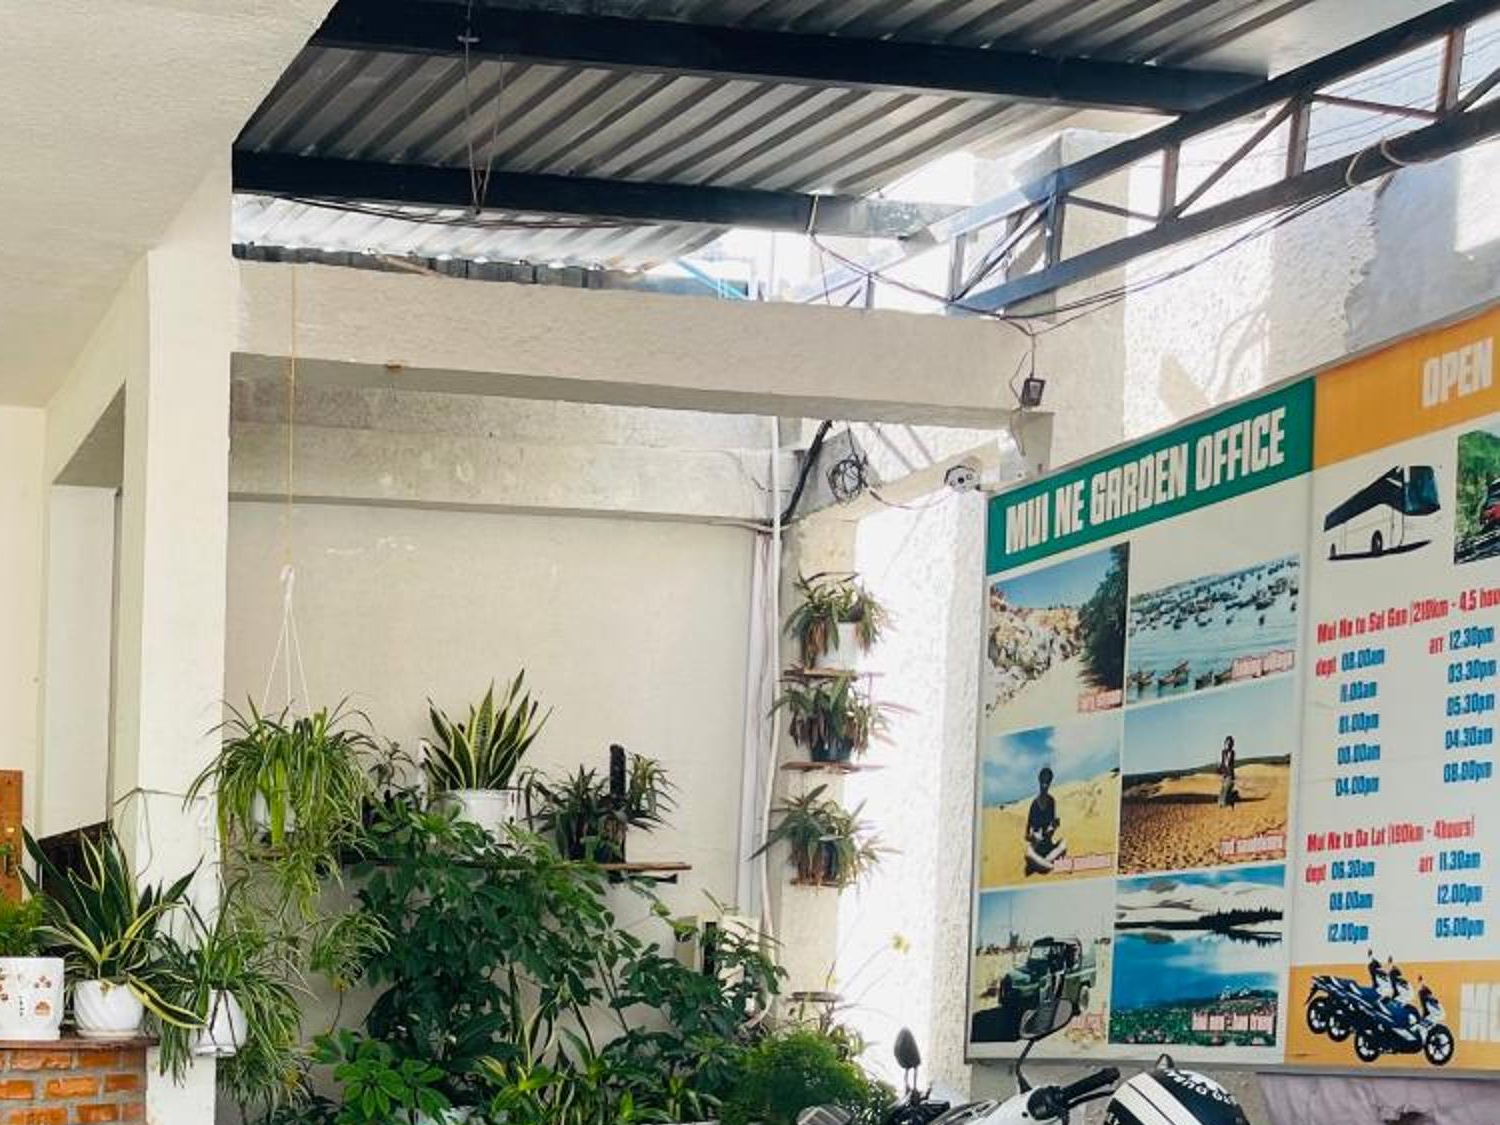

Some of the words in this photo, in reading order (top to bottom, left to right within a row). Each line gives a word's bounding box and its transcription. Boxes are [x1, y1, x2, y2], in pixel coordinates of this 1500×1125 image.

[1422, 336, 1493, 408] OPEN
[1005, 491, 1049, 555] MUI
[1053, 479, 1085, 539] NE
[1090, 442, 1188, 526] GARDEN
[1195, 405, 1287, 492] OFFICE
[1317, 622, 1337, 644] Mui
[1450, 626, 1495, 650] 12.30pm
[1448, 659, 1497, 683] 03.30pm
[1446, 692, 1495, 716] 05.30pm
[1307, 832, 1325, 852] Mui
[1327, 831, 1341, 850] Ne
[1356, 828, 1369, 848] Da
[1439, 850, 1481, 872] 11.30am
[1437, 883, 1483, 907] 12.00pm
